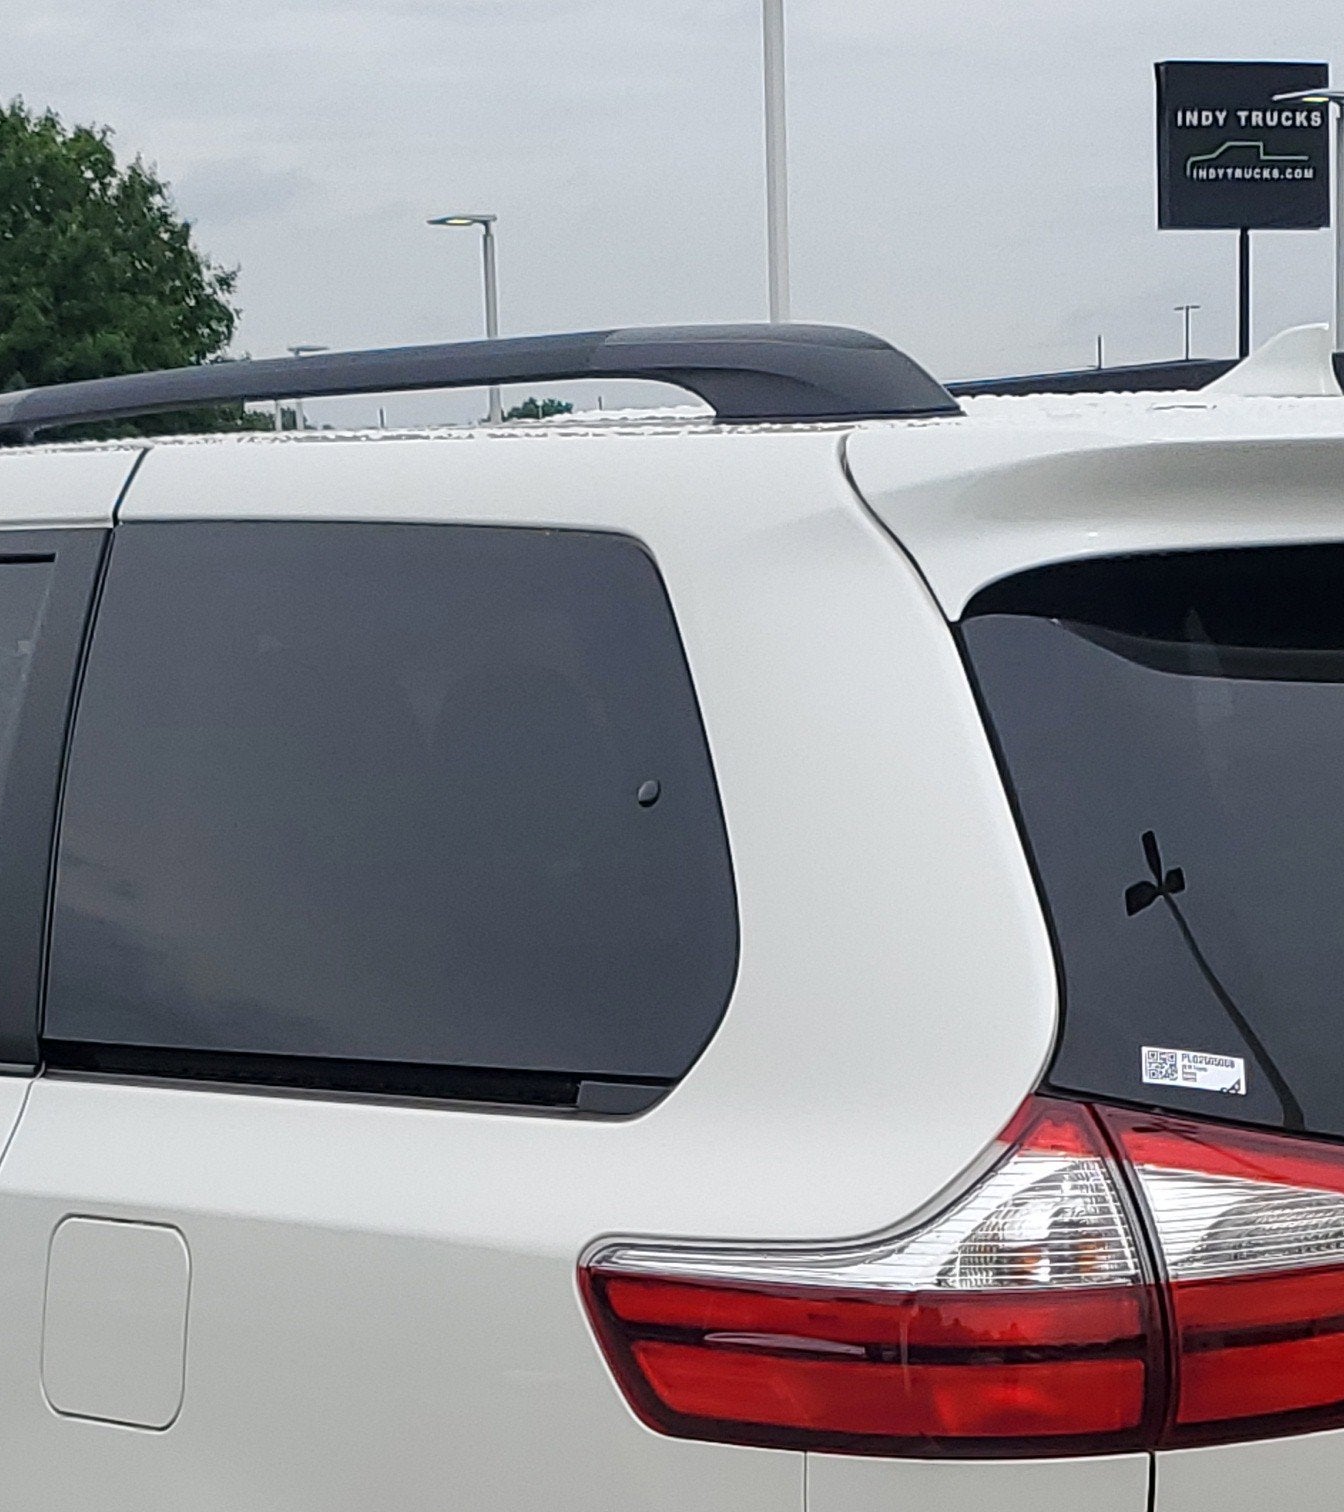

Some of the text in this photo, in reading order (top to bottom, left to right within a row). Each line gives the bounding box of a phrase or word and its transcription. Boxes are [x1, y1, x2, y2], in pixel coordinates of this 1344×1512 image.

[1177, 110, 1322, 126] INDY TRUCKS
[1193, 168, 1314, 180] INDYTRUCKS.COM
